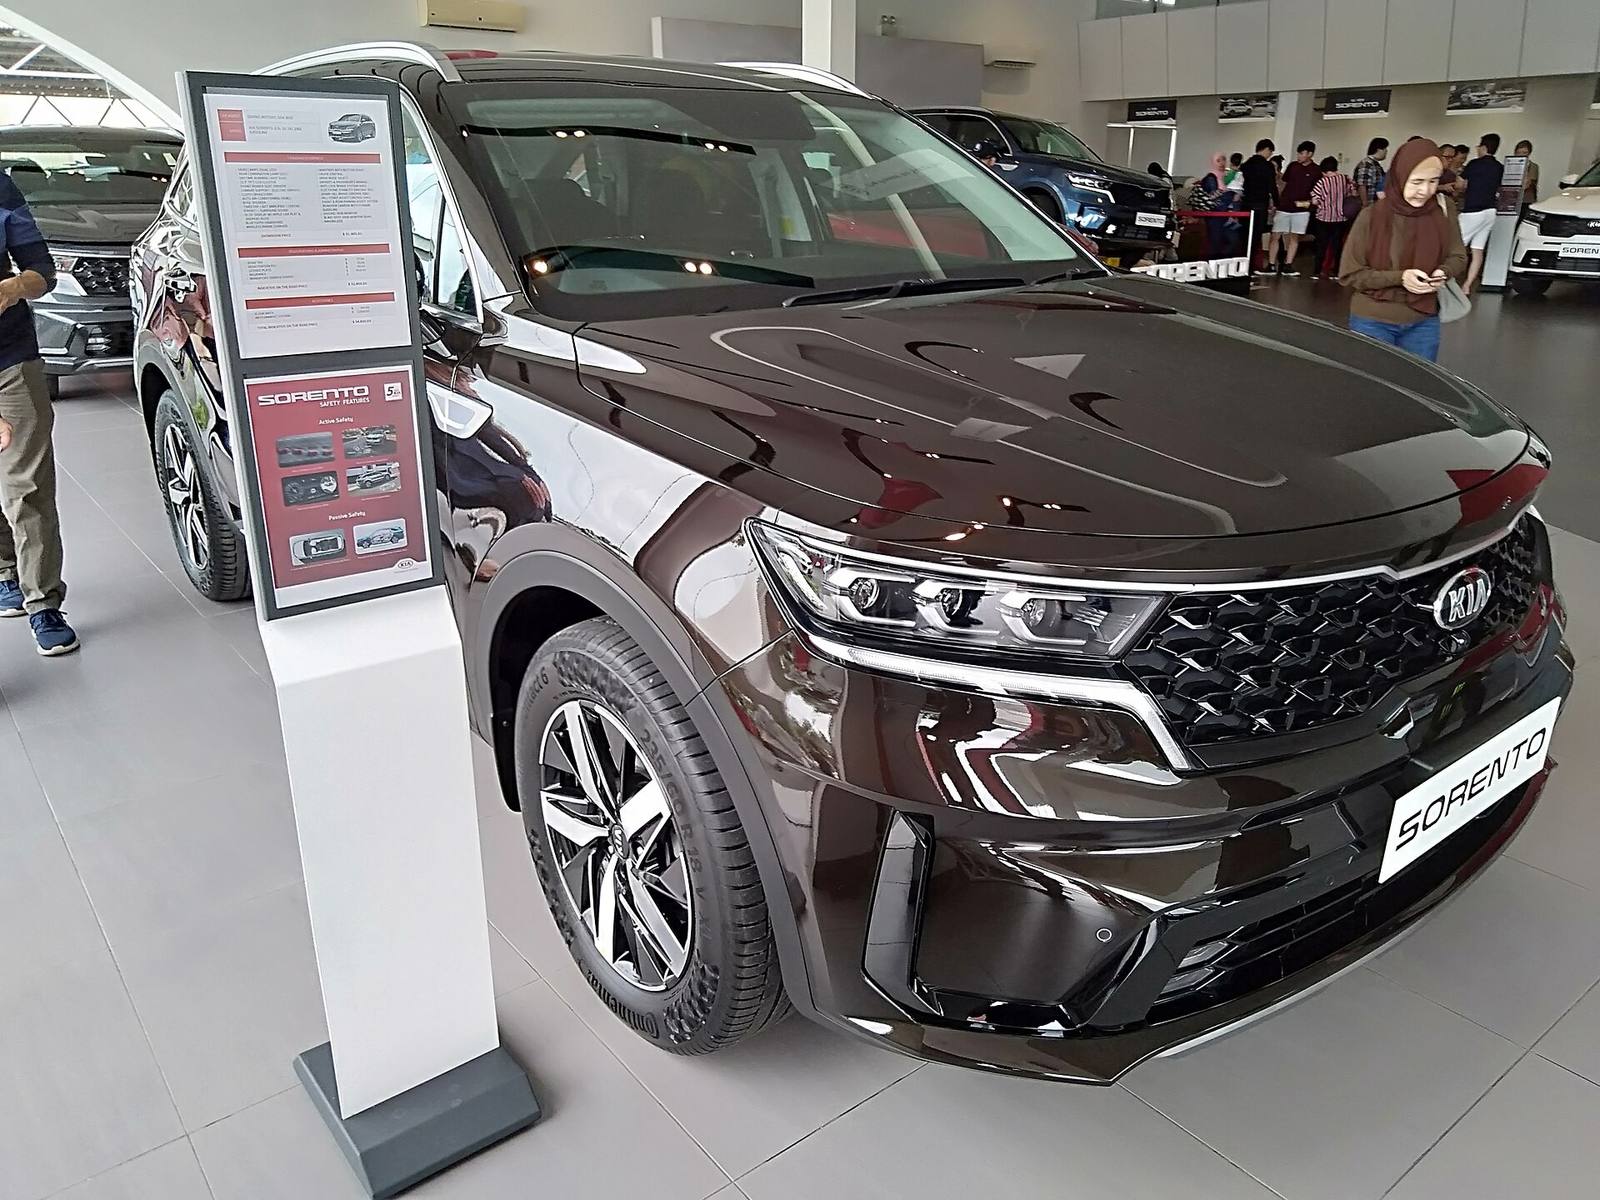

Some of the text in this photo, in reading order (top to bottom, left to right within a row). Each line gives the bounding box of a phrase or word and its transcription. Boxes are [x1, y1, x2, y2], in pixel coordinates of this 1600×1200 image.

[257, 385, 370, 406] SORENTO
[319, 397, 370, 408] SAFETY FEATURES
[335, 416, 354, 424] Safety
[1448, 578, 1488, 623] KIA
[1395, 727, 1547, 852] SORENTO
